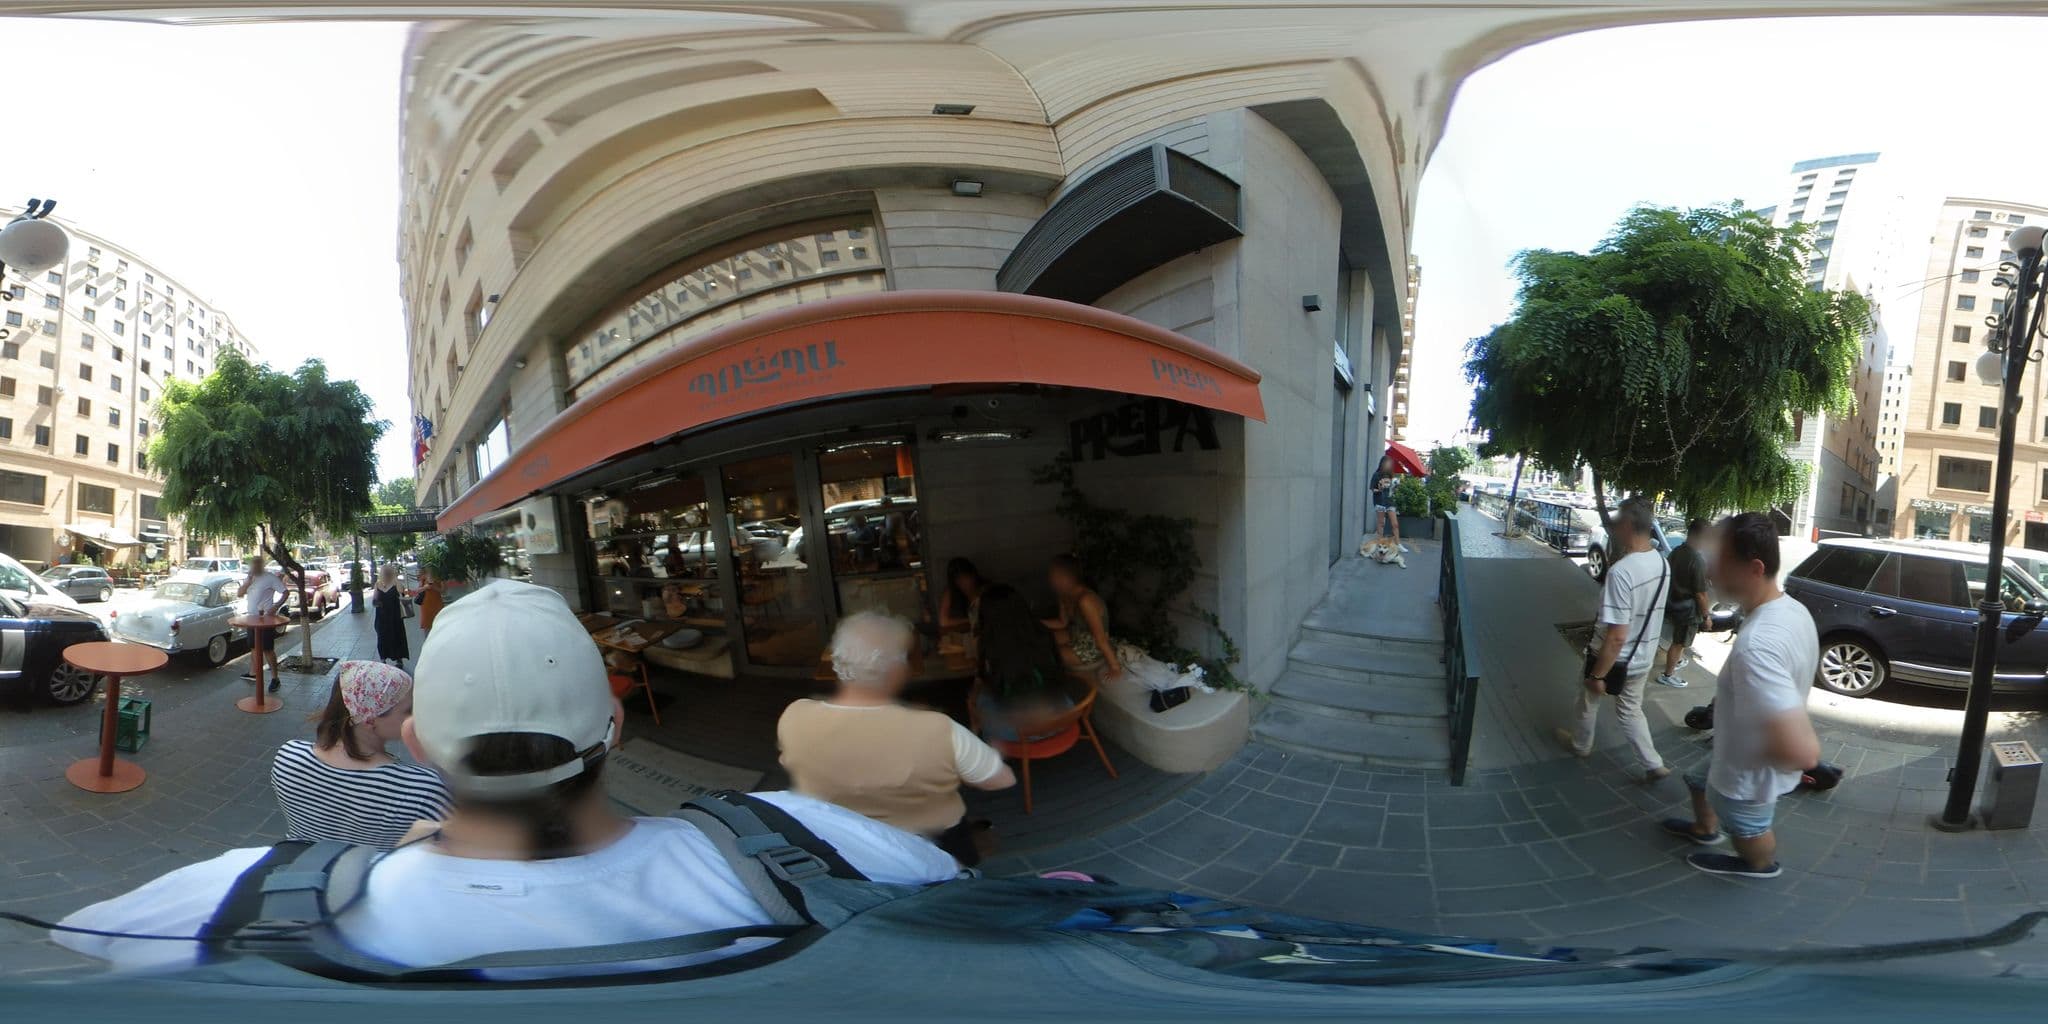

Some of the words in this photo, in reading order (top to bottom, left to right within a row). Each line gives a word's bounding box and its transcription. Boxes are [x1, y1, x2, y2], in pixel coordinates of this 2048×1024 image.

[1150, 357, 1223, 396] PREPA
[1069, 398, 1221, 462] PREPA
[359, 515, 418, 524] ОСТИНИЦА
